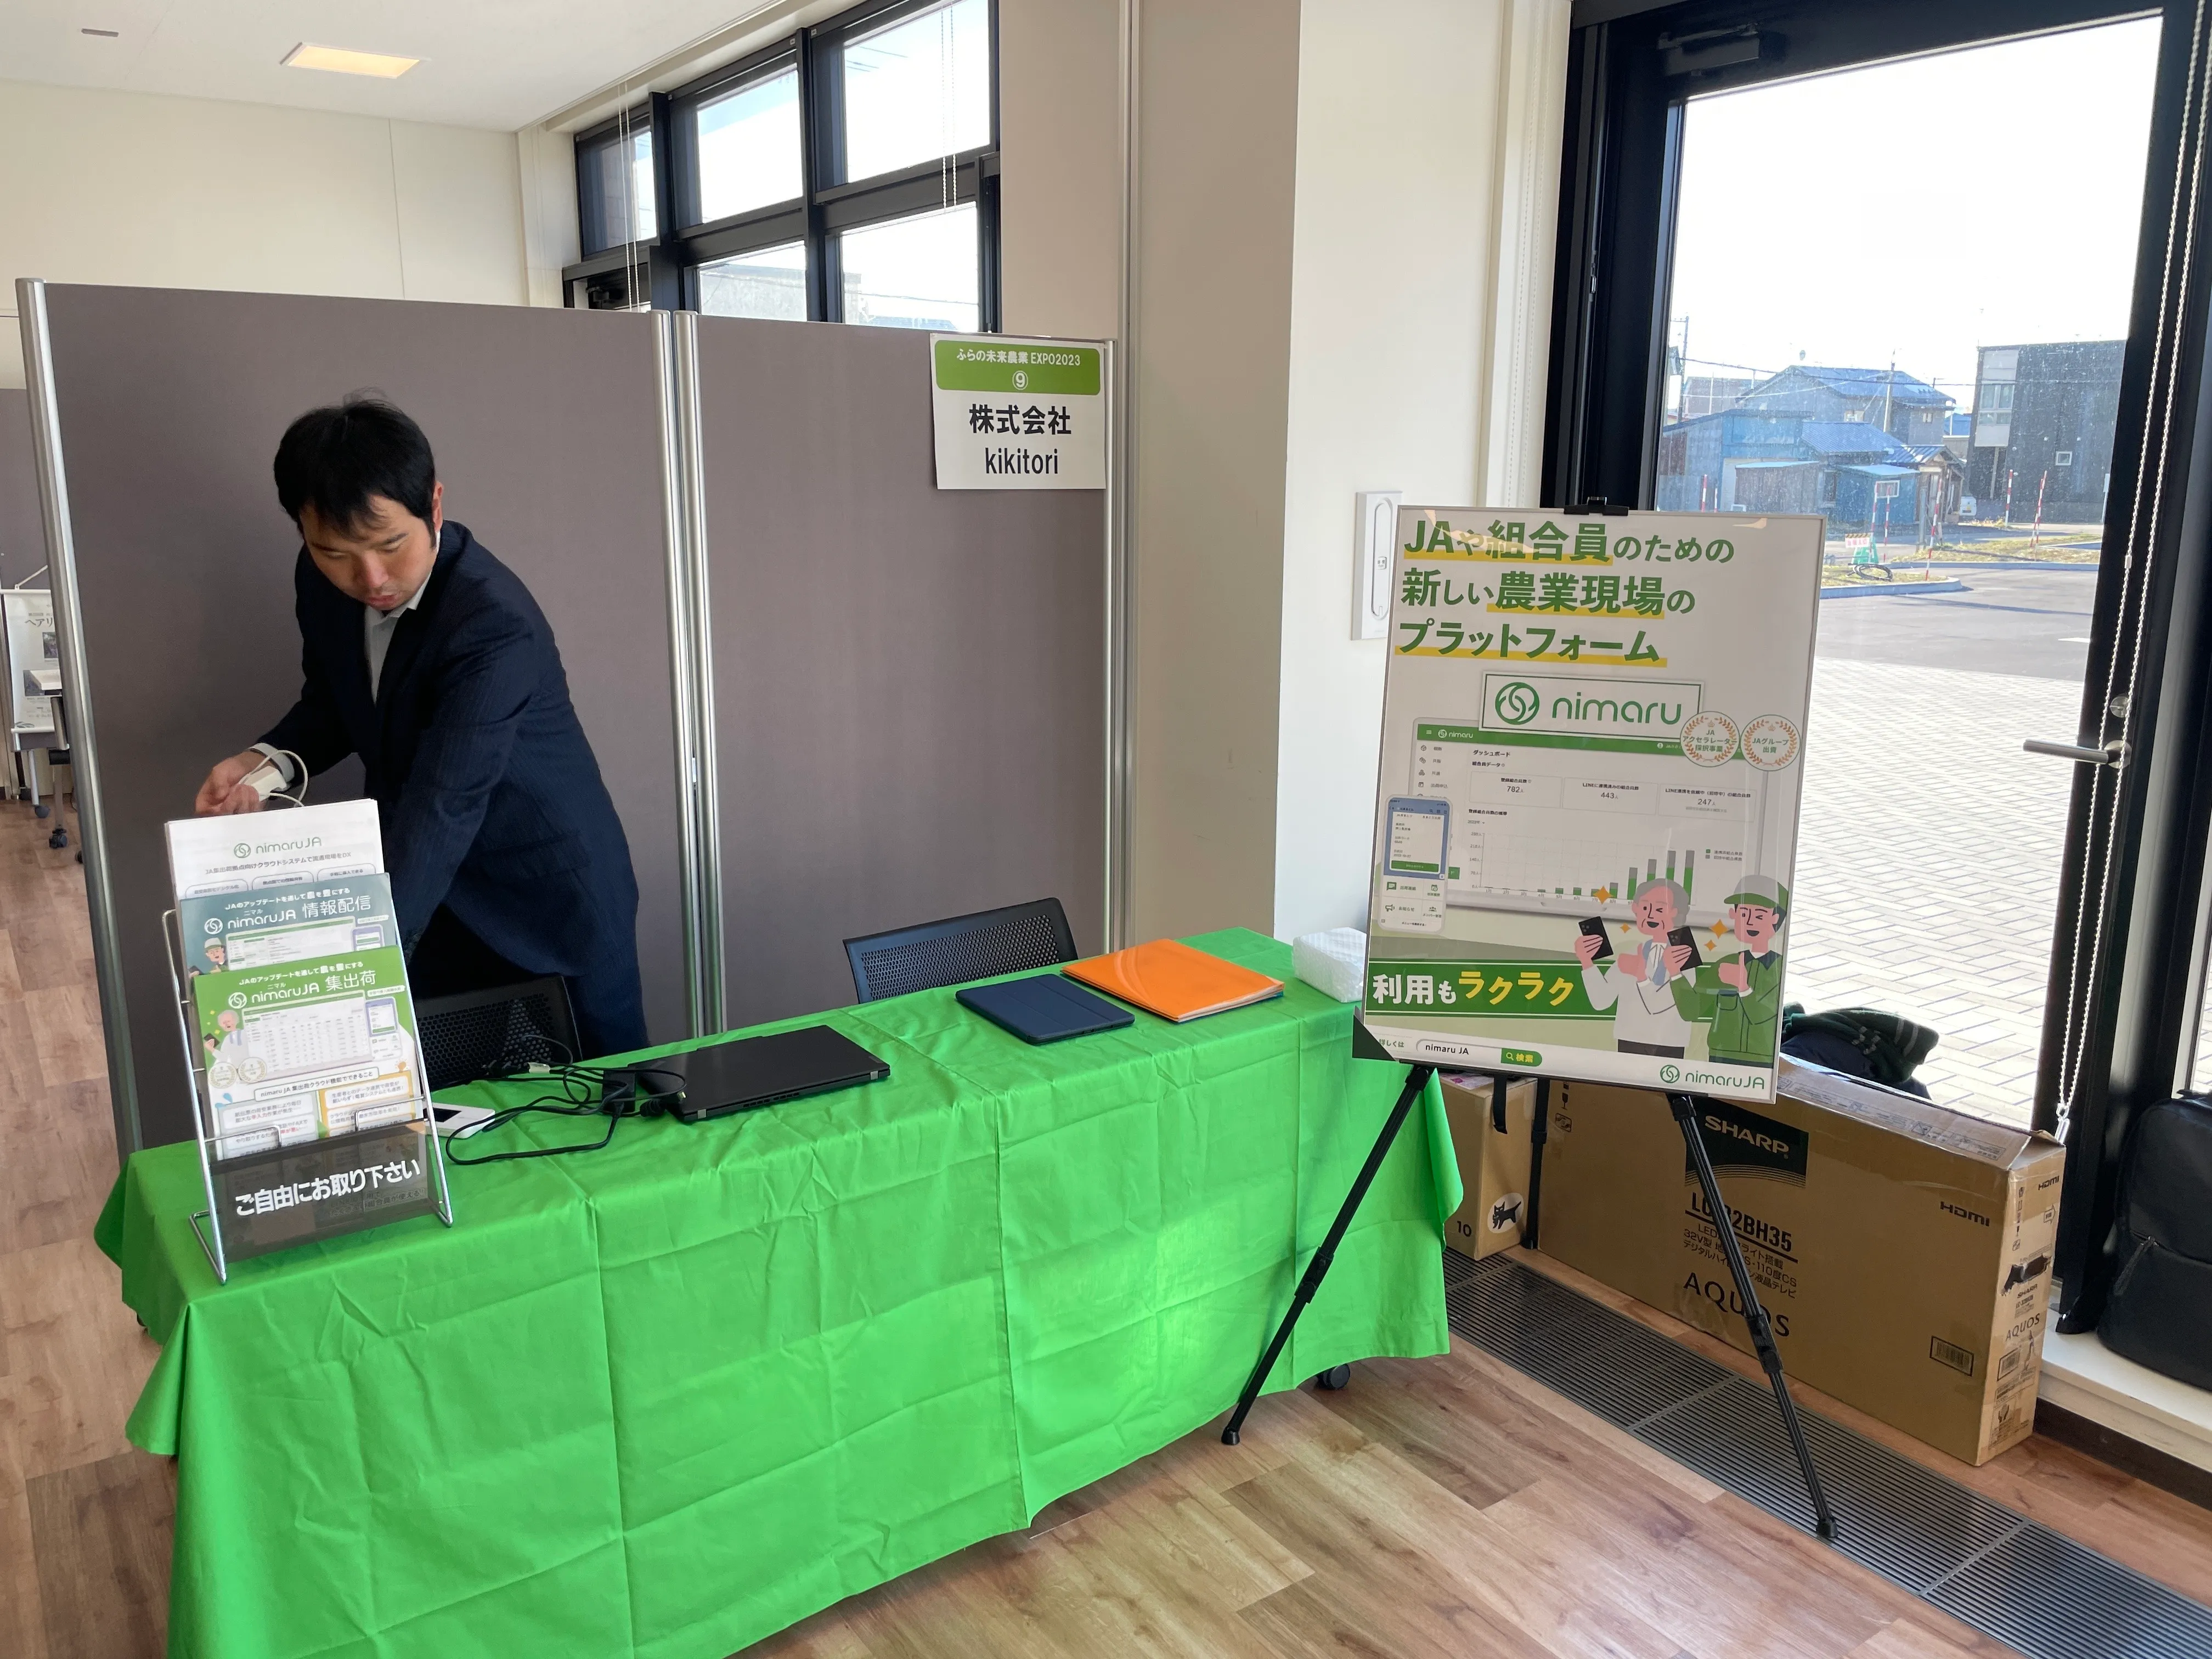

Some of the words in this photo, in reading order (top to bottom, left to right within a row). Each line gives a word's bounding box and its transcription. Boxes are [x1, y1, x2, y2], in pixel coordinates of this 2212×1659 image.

[957, 349, 1028, 364] ふらの未来農業
[1031, 353, 1080, 365] EXPO2023
[969, 404, 1071, 435] 株式会社
[985, 448, 1058, 474] kikitori
[1404, 520, 1734, 564] JAや組合員のための
[1400, 568, 1696, 615] 新しい農業現場の
[1399, 618, 1660, 662] プラットフォーム
[1552, 692, 1682, 725] nimaru
[1683, 736, 1737, 745] アクセラレーター
[244, 908, 263, 916] ニマル
[302, 895, 371, 918] 情報配信
[325, 970, 376, 992] 集出荷
[1373, 971, 1575, 1006] 利用もラクラク
[1425, 1043, 1455, 1053] nimaru
[1459, 1047, 1469, 1055] JA
[1516, 1052, 1534, 1064] 検索
[1705, 1115, 1789, 1154] SHARP
[235, 1159, 421, 1216] ご自由にお取り下さい
[2038, 1175, 2060, 1191] HDMI
[1940, 1201, 1990, 1227] HDMI
[1457, 1221, 1472, 1237] 10
[2017, 1284, 2038, 1298] SHARP
[2006, 1313, 2040, 1341] AQUOS
